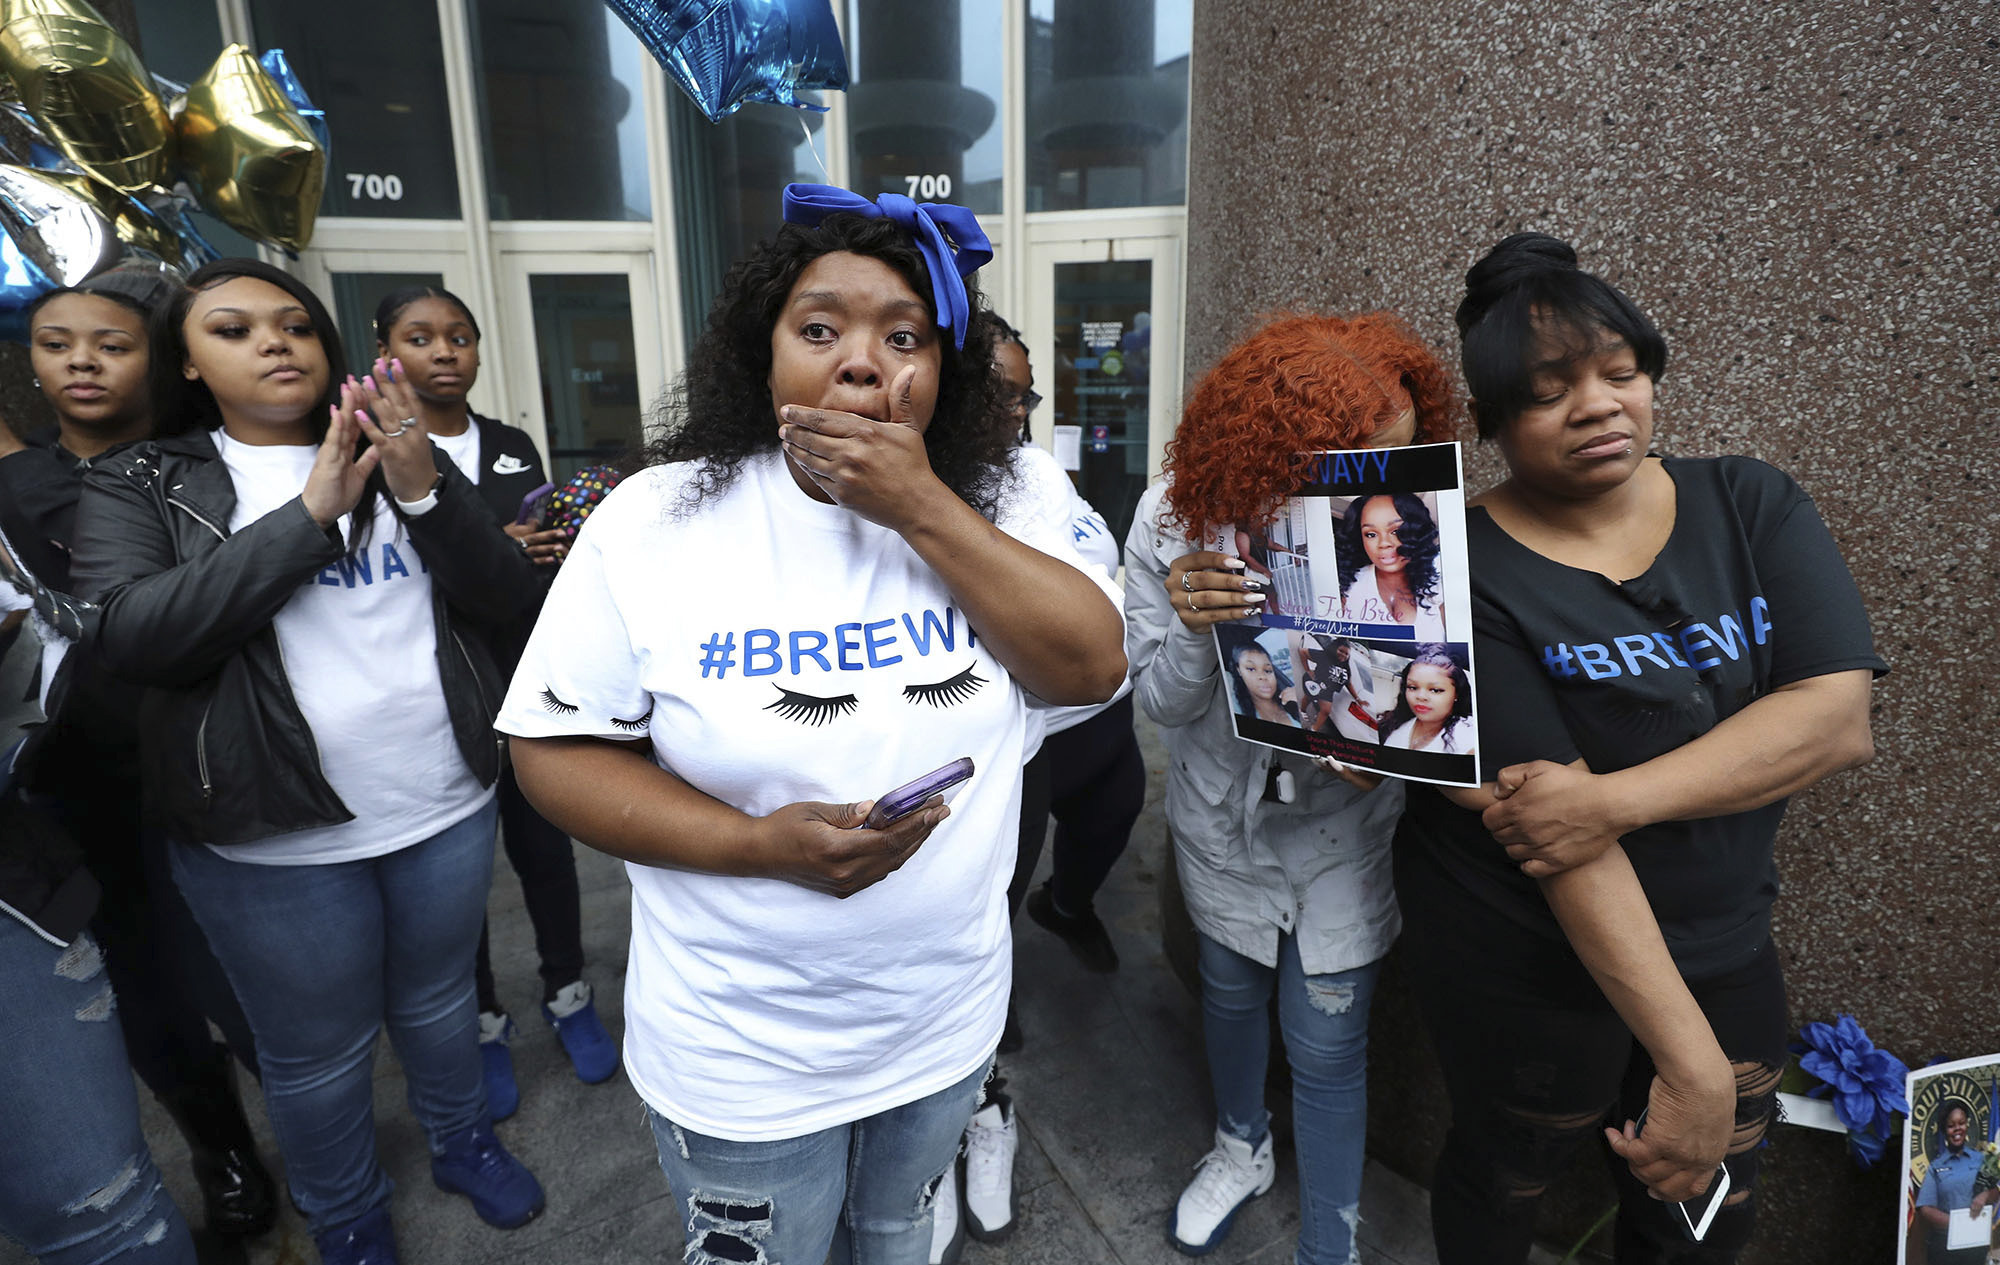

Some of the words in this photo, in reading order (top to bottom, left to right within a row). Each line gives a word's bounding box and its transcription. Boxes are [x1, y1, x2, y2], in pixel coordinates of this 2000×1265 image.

[346, 173, 403, 200] 700
[905, 174, 951, 199] 700
[1317, 596, 1353, 619] For
[1360, 598, 1404, 622] Bree
[1912, 1077, 1989, 1132] LOUISVILLE
